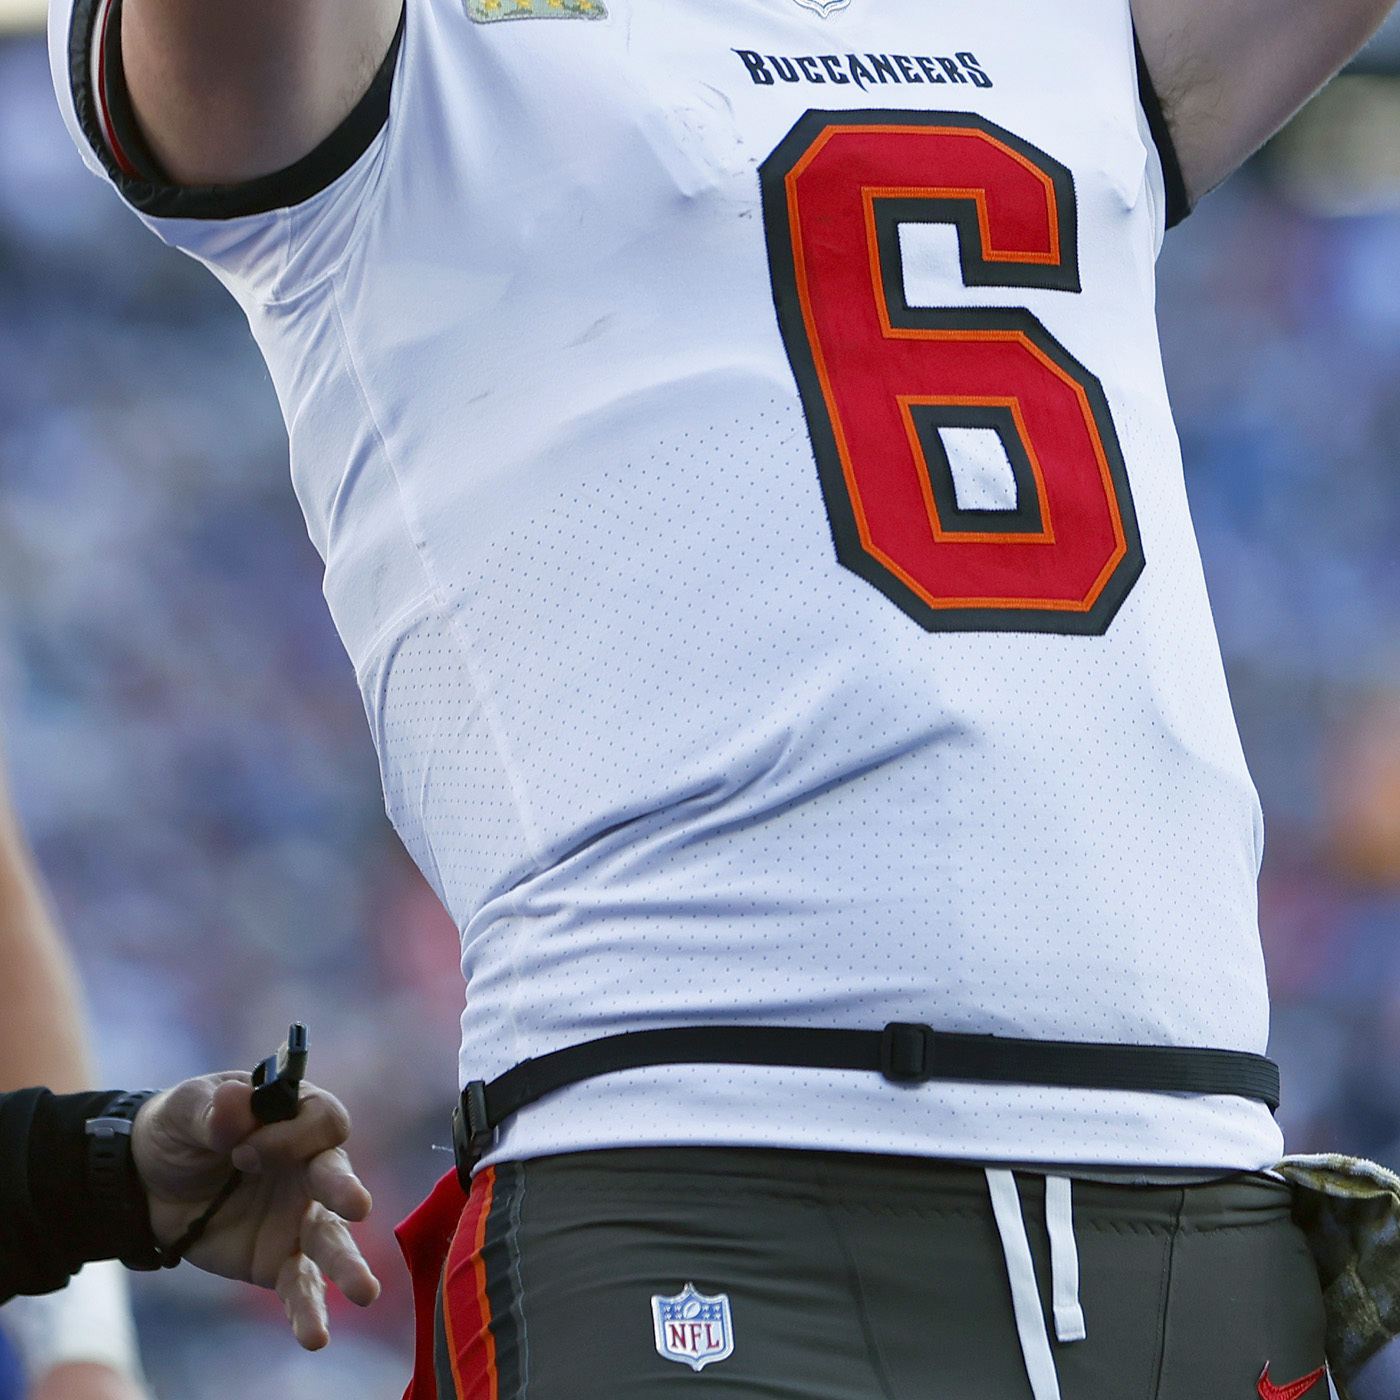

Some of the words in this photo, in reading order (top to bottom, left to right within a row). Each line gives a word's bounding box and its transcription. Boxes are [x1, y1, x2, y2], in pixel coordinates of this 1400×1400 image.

[730, 48, 994, 92] BUCCANEERS
[758, 108, 1146, 637] 6
[669, 1323, 720, 1352] NFL
